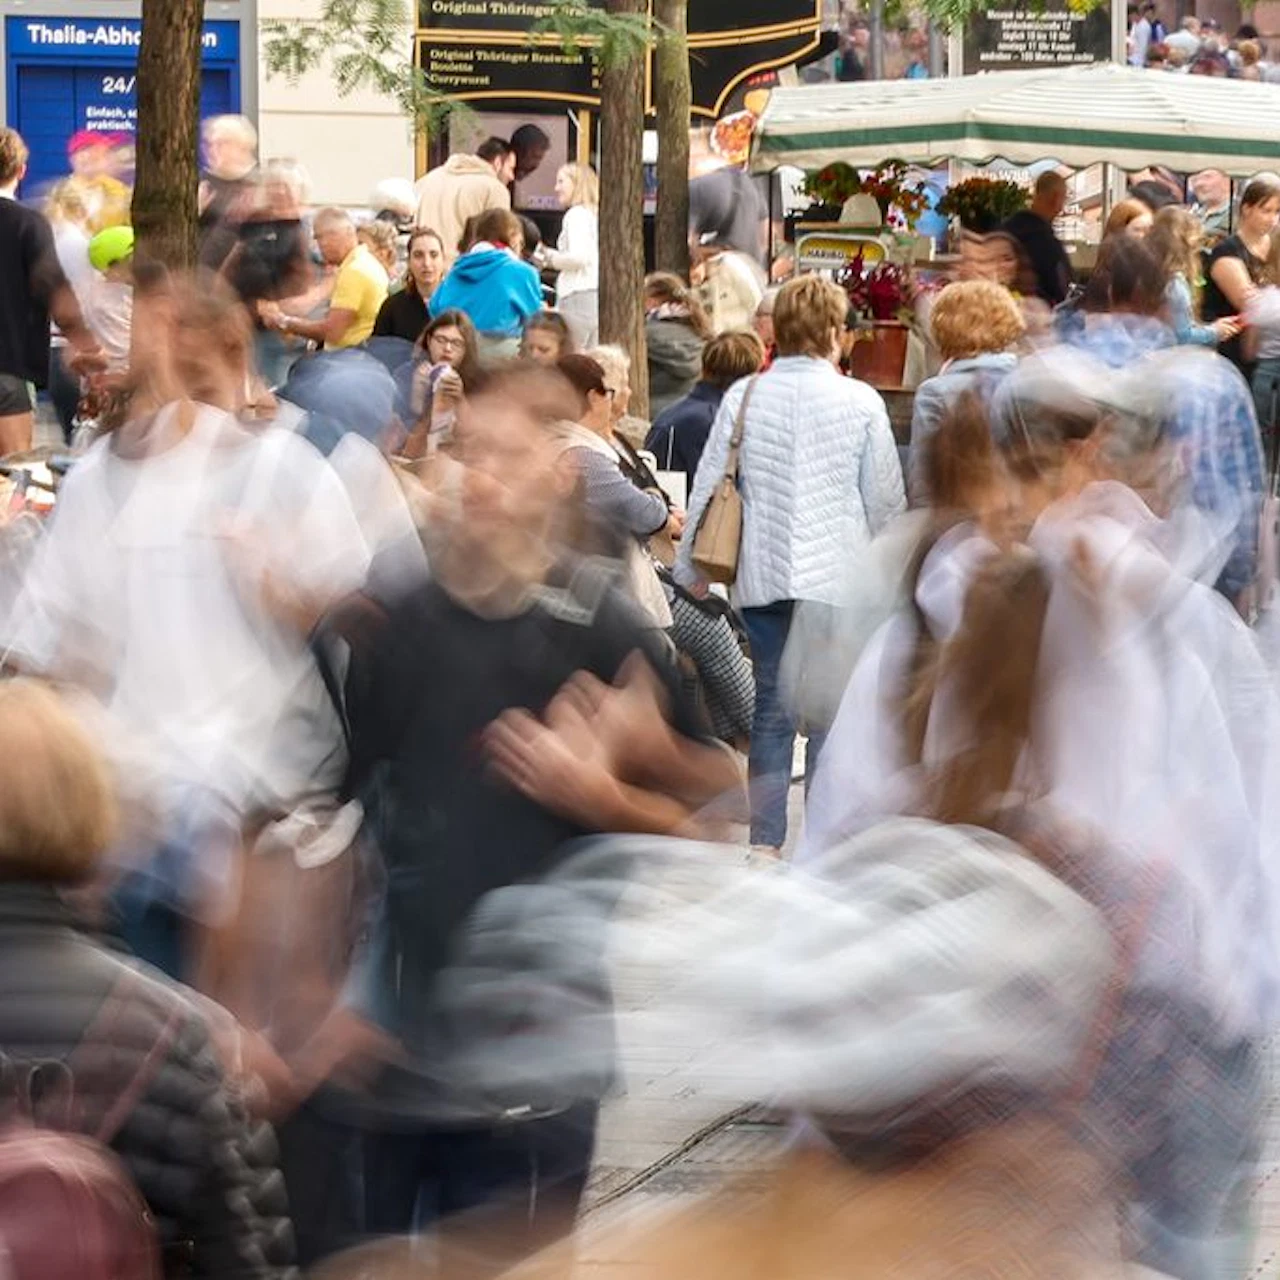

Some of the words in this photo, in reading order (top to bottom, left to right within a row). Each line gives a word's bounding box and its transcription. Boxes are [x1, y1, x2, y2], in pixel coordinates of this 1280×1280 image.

[432, 1, 487, 15] Original
[490, 2, 556, 18] Thüringer
[430, 49, 474, 62] Original
[476, 51, 529, 66] Thüringer
[102, 76, 136, 94] 24/
